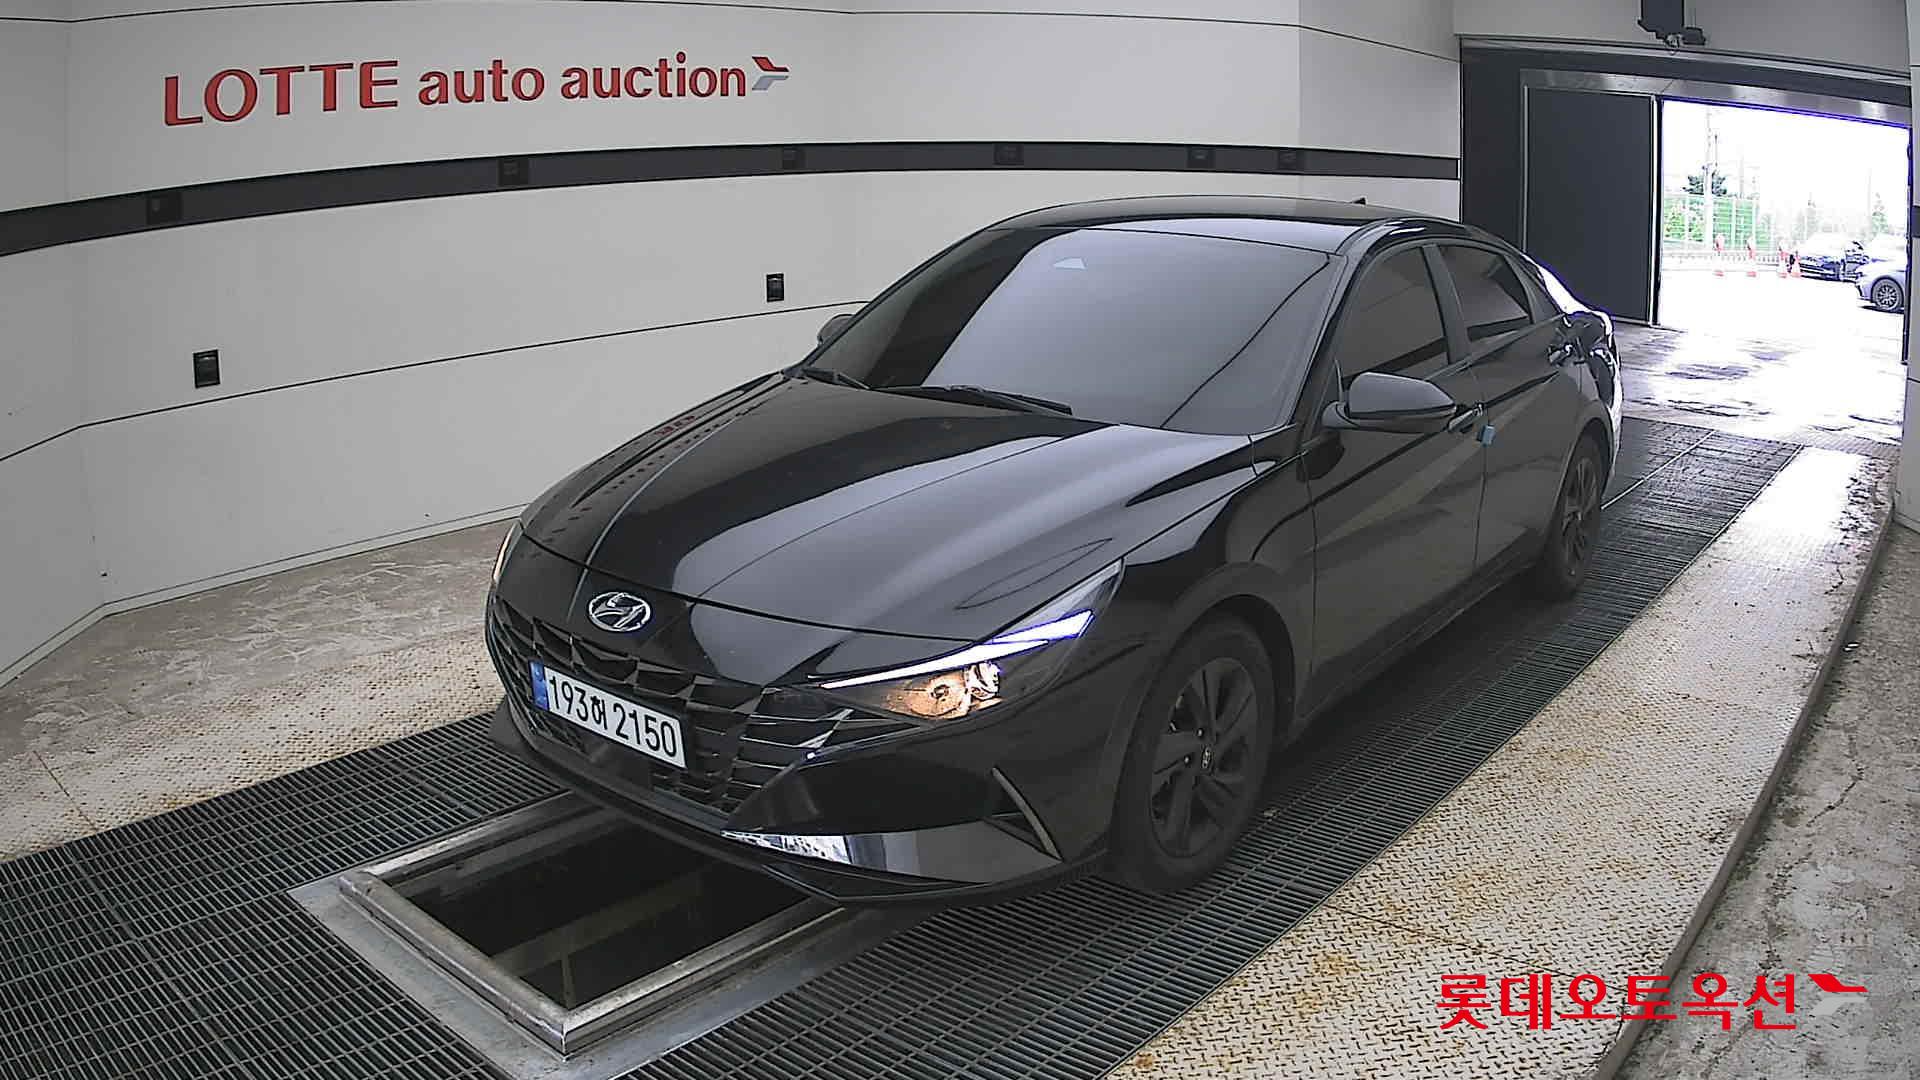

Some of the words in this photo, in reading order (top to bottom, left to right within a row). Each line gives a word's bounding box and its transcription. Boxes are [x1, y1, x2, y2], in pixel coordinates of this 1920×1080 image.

[164, 60, 399, 126] LOTTE
[418, 59, 546, 105] auto
[561, 51, 747, 99] auction
[549, 676, 608, 730] 193허
[613, 702, 677, 758] 2150
